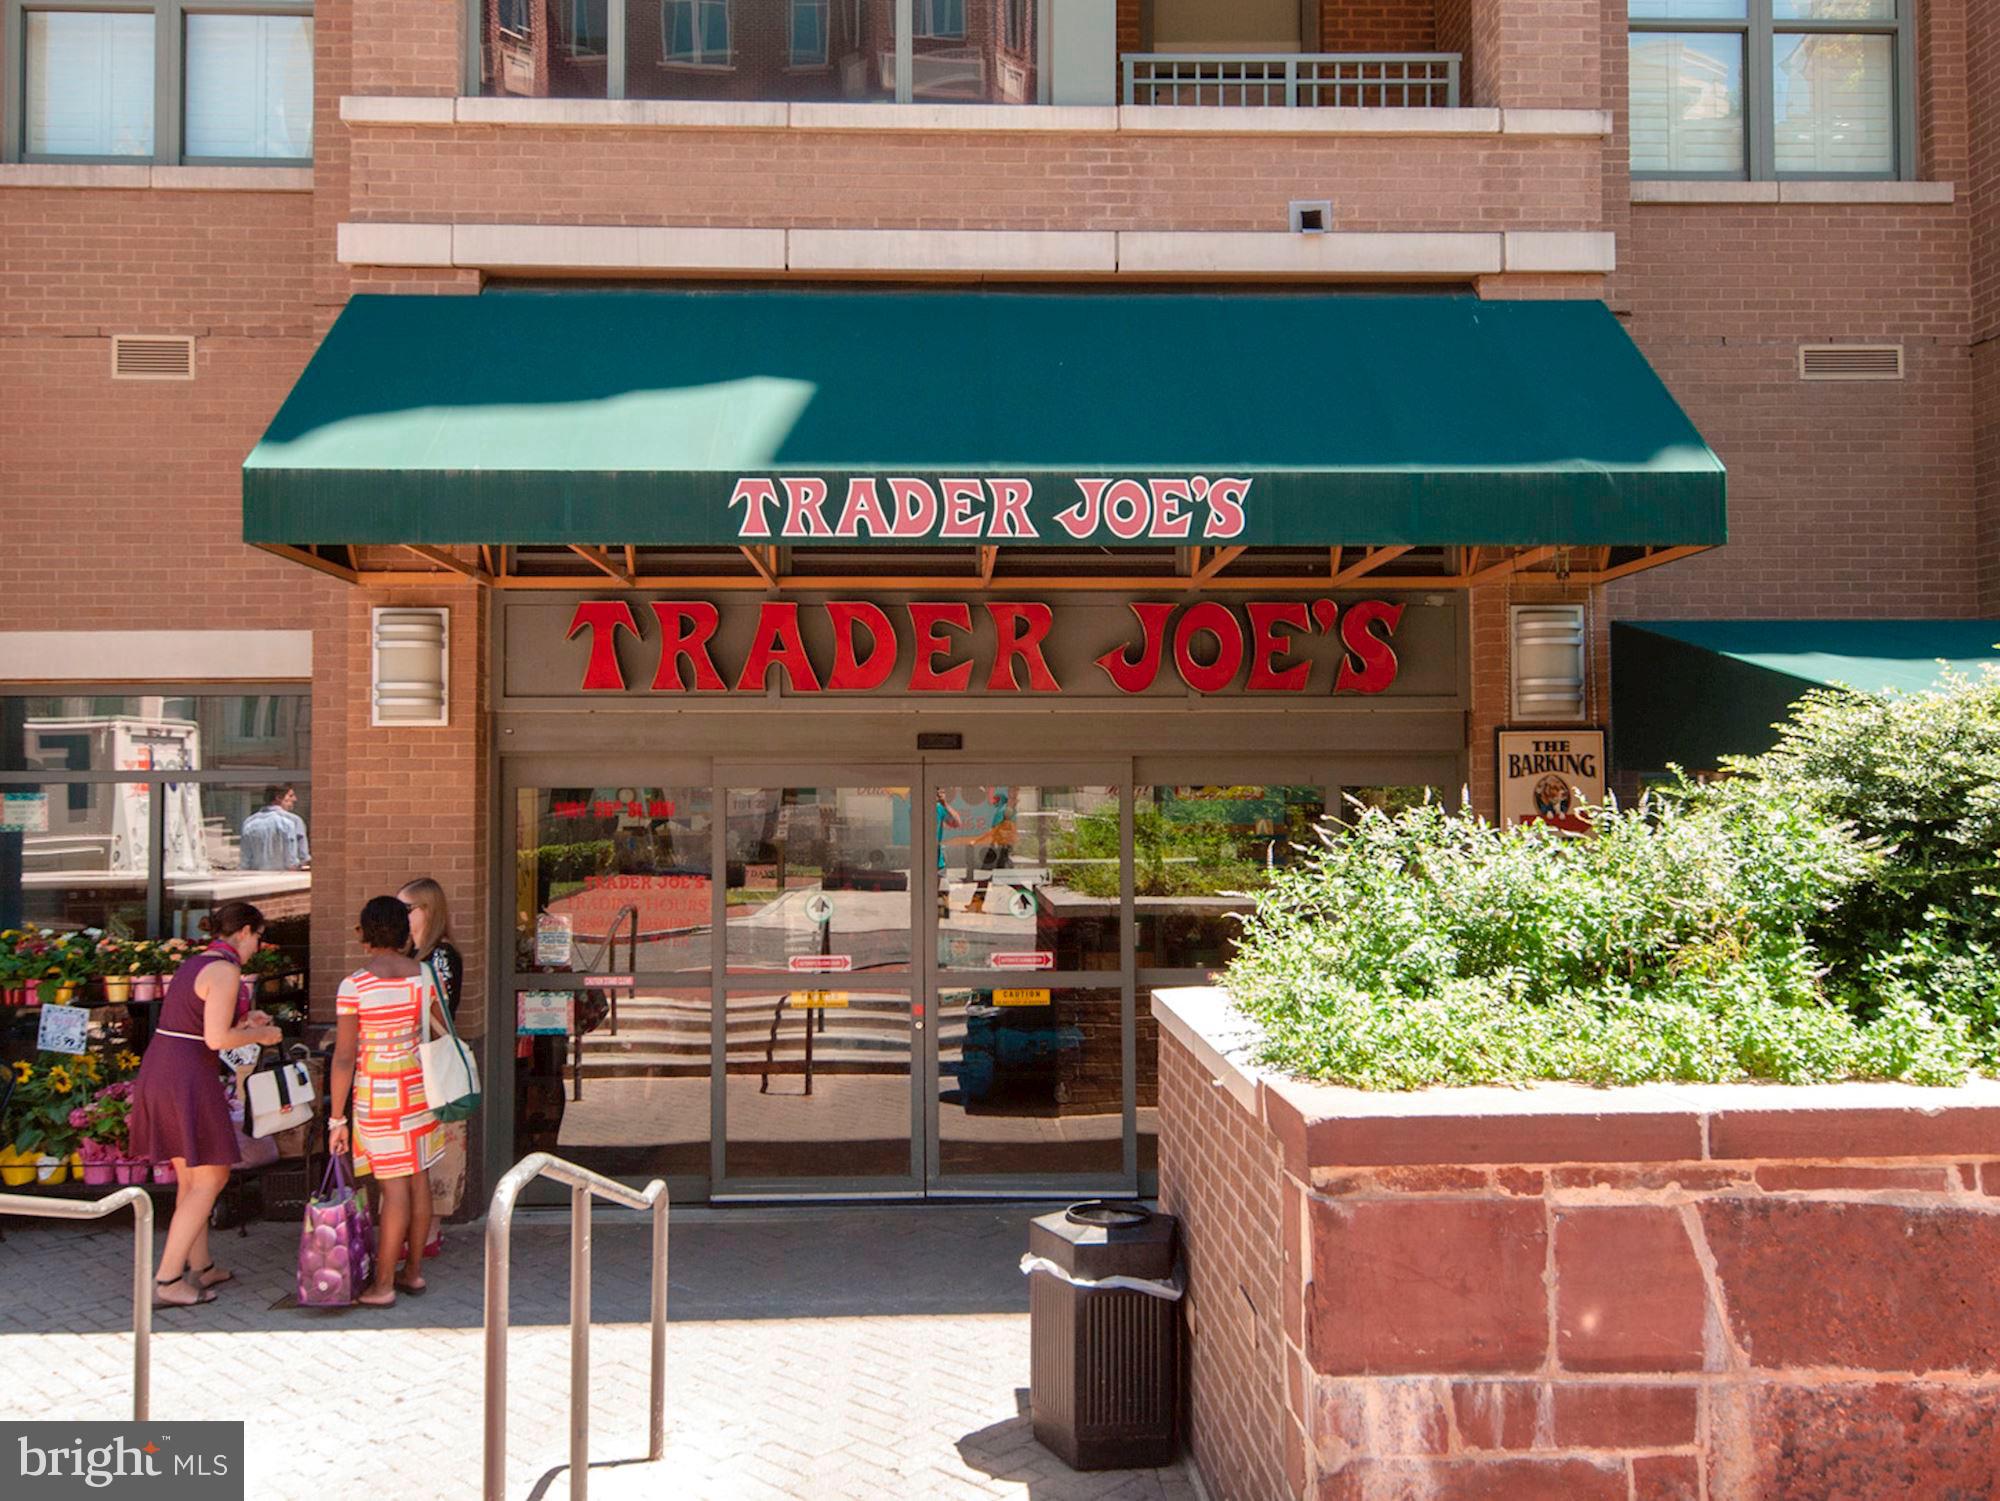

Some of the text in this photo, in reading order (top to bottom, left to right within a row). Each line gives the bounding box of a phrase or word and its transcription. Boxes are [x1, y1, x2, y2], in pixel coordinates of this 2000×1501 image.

[728, 475, 1254, 539] TRADER JOE'S
[564, 598, 1406, 693] TRADER JOE'S
[1531, 740, 1571, 753] THE
[1507, 753, 1598, 779] BARKING
[583, 874, 706, 890] TRADER JOE'S
